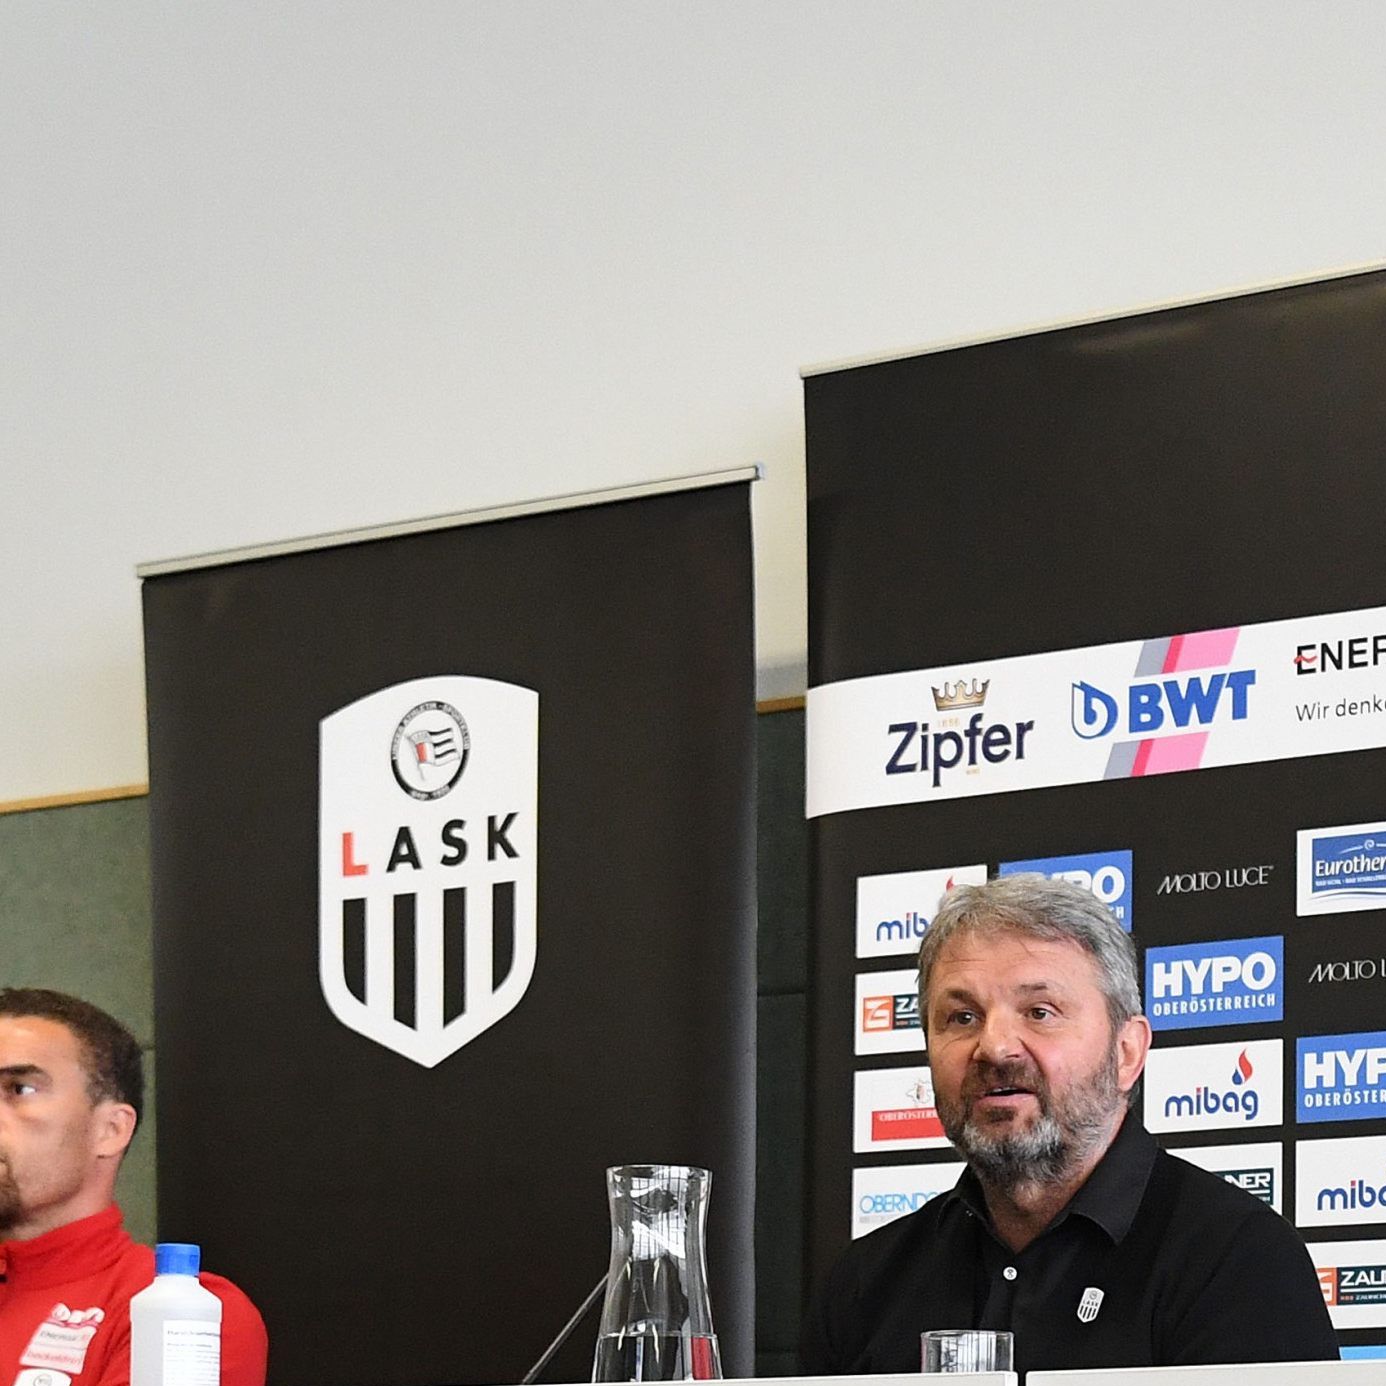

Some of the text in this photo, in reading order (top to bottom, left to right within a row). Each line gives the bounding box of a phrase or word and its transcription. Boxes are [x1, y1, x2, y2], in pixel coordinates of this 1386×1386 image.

[1128, 669, 1257, 734] BWT
[1296, 702, 1330, 721] Wir
[885, 712, 1035, 788] Zipfer
[341, 811, 520, 877] LASK
[1157, 865, 1270, 895] MOLTO LUCE
[876, 912, 930, 941] mib
[1152, 951, 1277, 999] HYPO
[1308, 960, 1376, 984] MOLTO
[1153, 993, 1276, 1017] OBERÖSTERREICH
[1165, 1086, 1258, 1121] mibag
